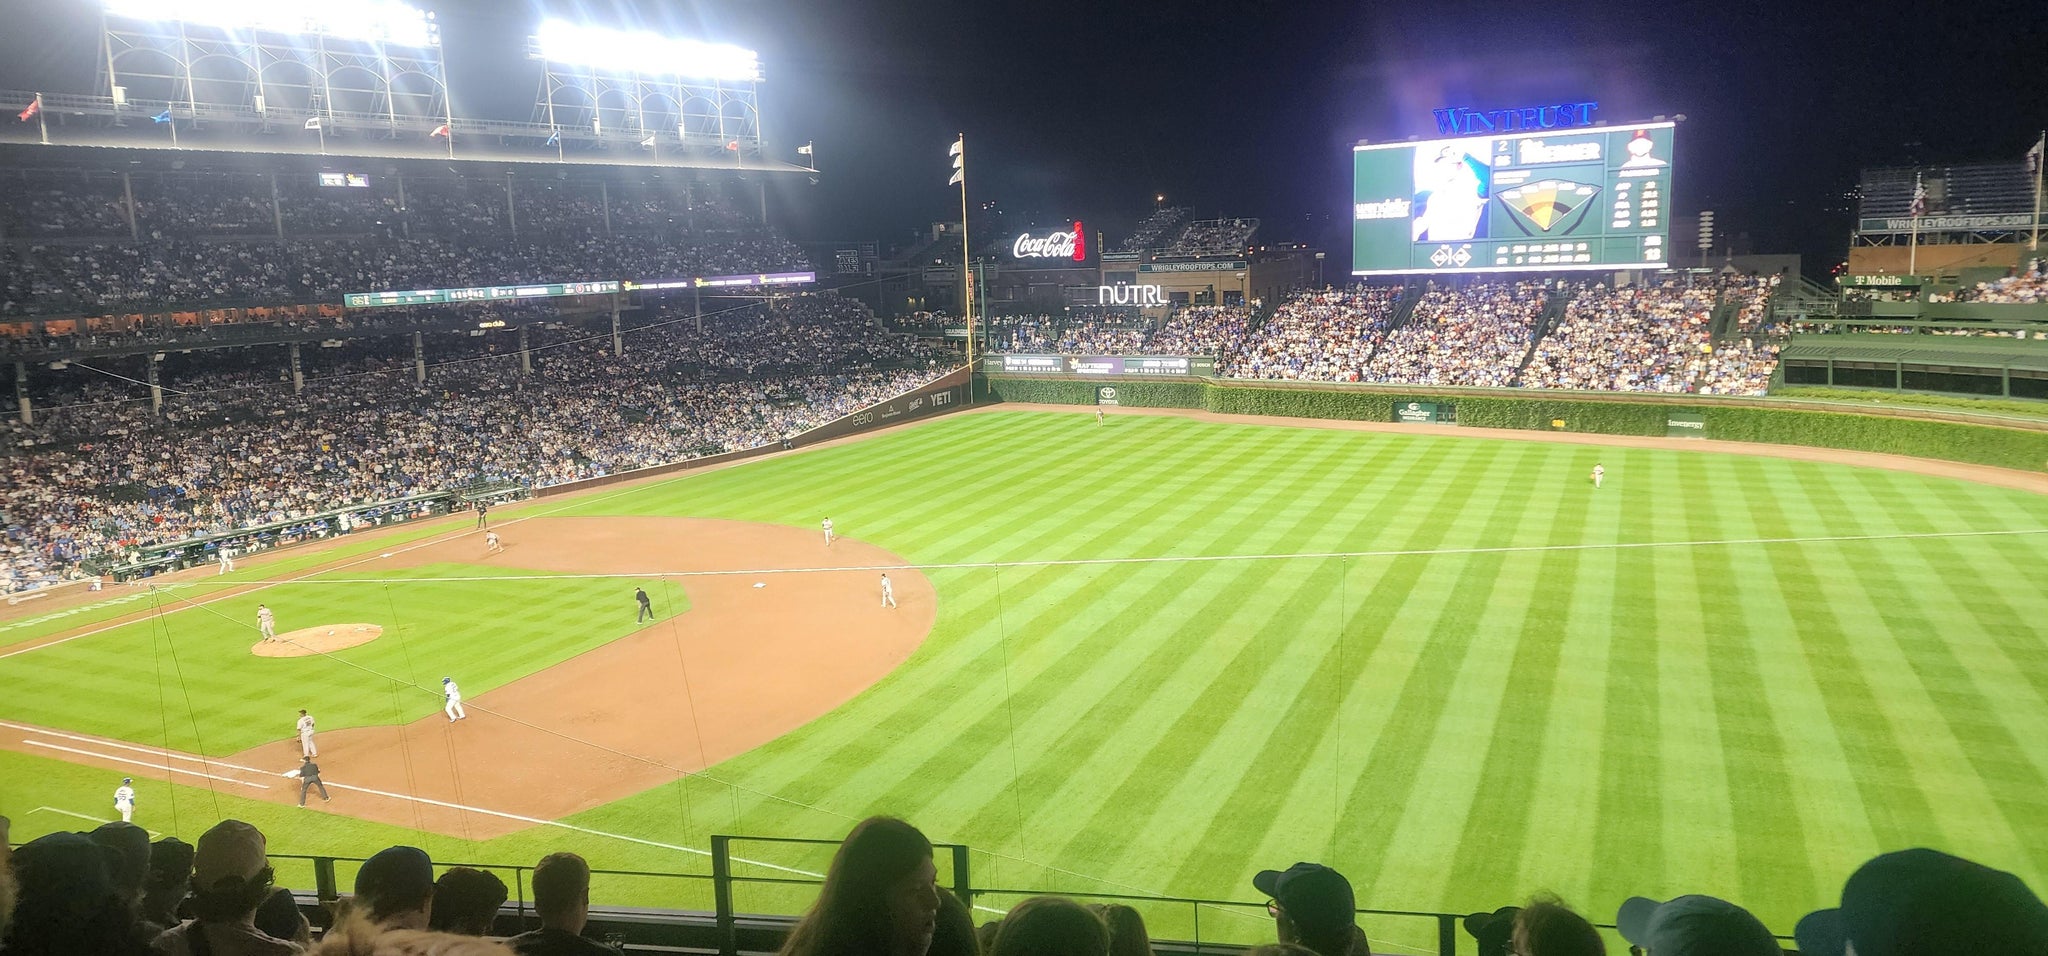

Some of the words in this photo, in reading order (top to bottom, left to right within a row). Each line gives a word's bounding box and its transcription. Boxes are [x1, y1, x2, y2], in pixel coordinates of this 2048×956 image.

[1433, 102, 1598, 135] WINTRUST
[1498, 141, 1508, 152] 2
[1013, 231, 1077, 258] Coca-Cola
[1151, 262, 1234, 272] WRIGLEYROOFTOPS.COM
[1866, 275, 1902, 285] Mobile
[984, 359, 1003, 367] Harvey
[930, 391, 951, 407] YETI
[852, 411, 873, 426] eero
[1667, 419, 1705, 429] Invenergy
